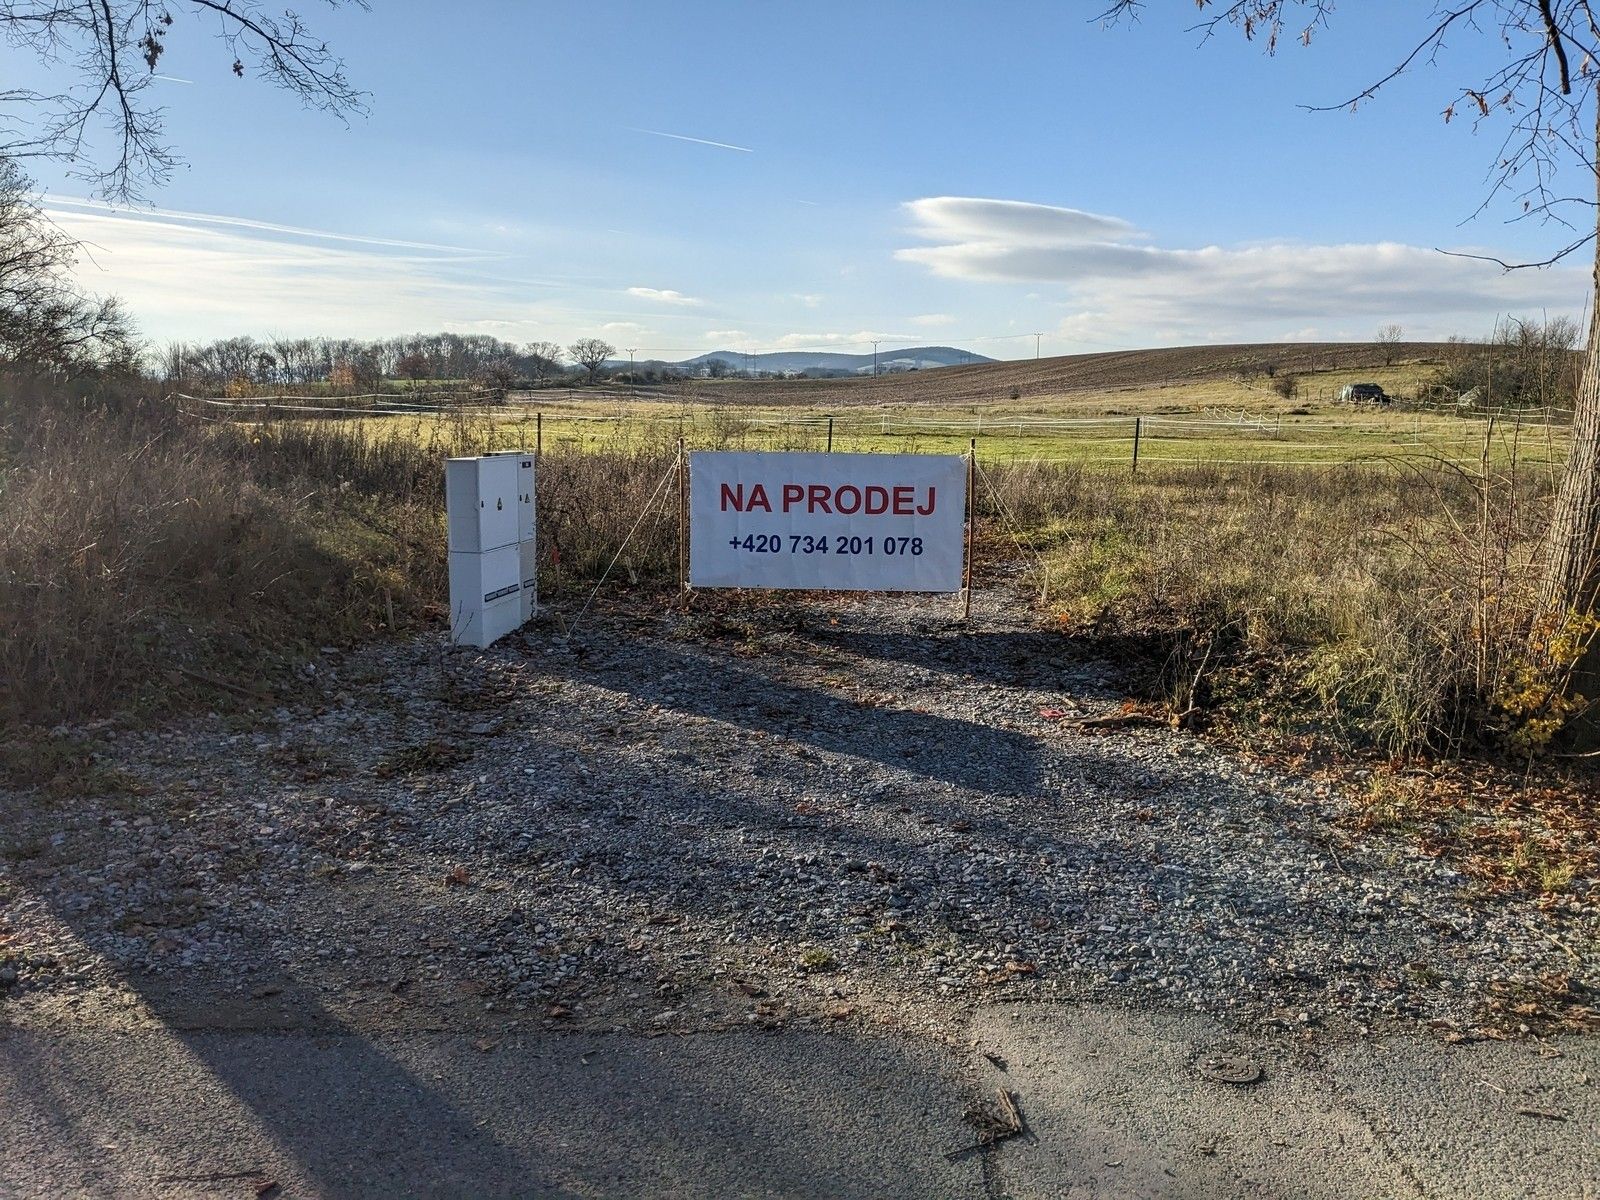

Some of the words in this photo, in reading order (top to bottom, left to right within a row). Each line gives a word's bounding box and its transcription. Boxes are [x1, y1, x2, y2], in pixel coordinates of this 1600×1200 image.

[720, 483, 772, 513] NA
[783, 484, 936, 516] PRODEJ
[729, 534, 782, 554] +420
[789, 535, 829, 554] 734
[836, 536, 874, 555] 201
[883, 537, 924, 556] 078
